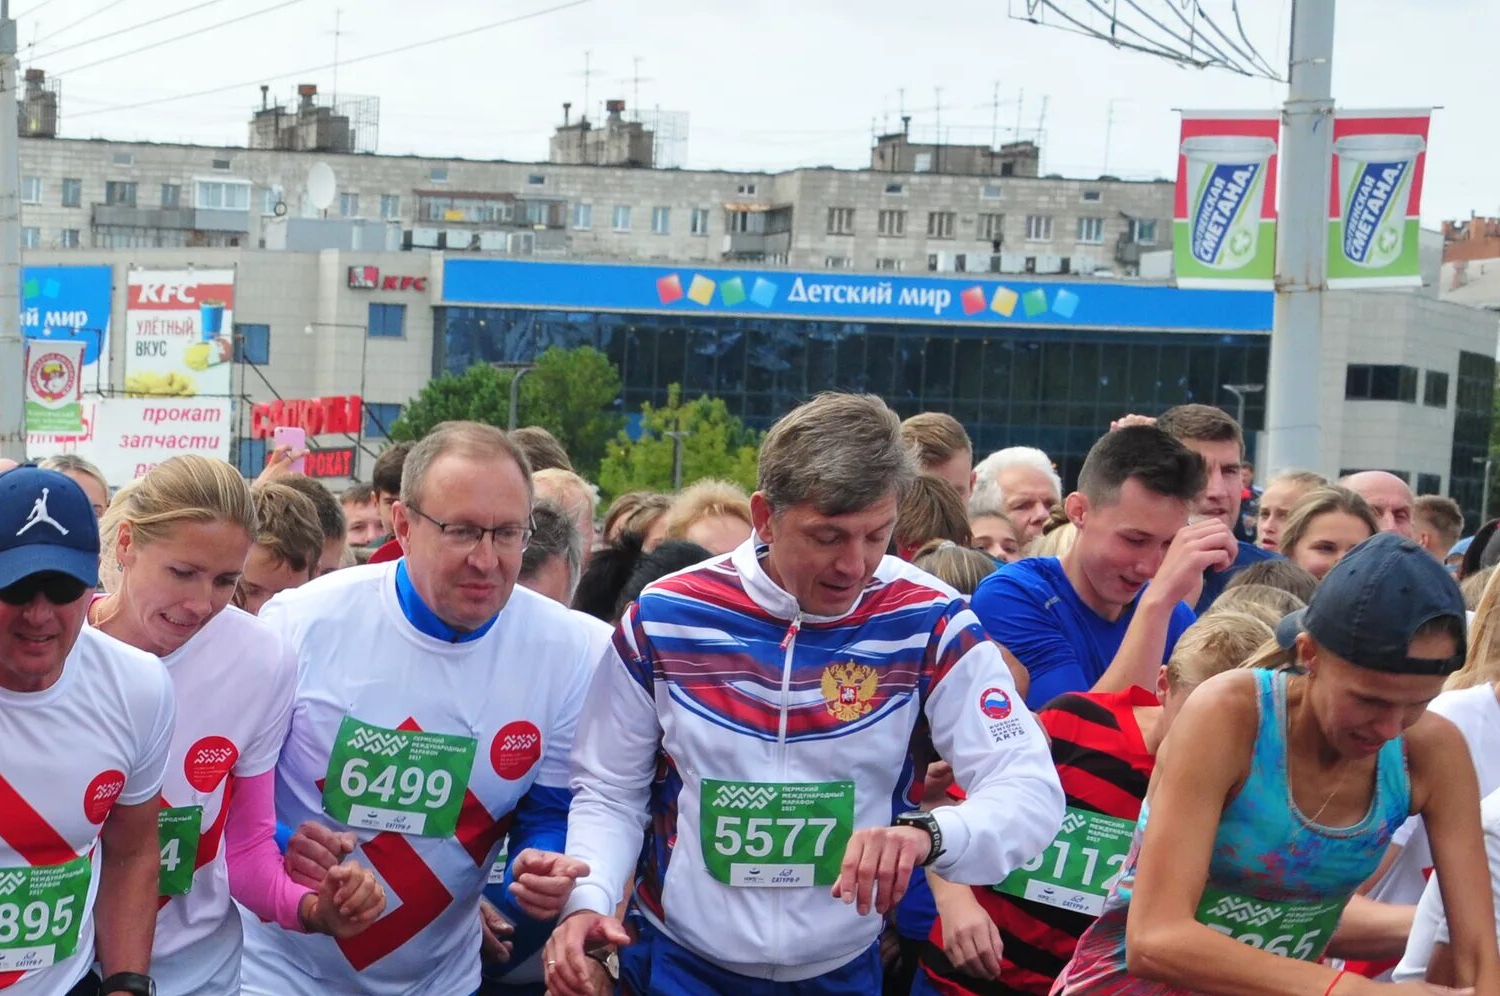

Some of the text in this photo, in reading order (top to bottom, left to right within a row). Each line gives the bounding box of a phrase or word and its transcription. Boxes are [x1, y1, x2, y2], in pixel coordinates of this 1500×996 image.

[137, 283, 197, 303] KFC
[381, 275, 427, 292] KFC
[787, 276, 951, 315] Детский мир
[43, 311, 88, 332] мир
[135, 317, 194, 336] УЛЁТНЫЙ
[135, 340, 167, 356] ВКУС
[142, 407, 221, 424] прокат
[119, 434, 220, 449] запчасти
[996, 730, 1026, 743] ARTS
[341, 759, 452, 810] 6499
[714, 818, 837, 857] 5577
